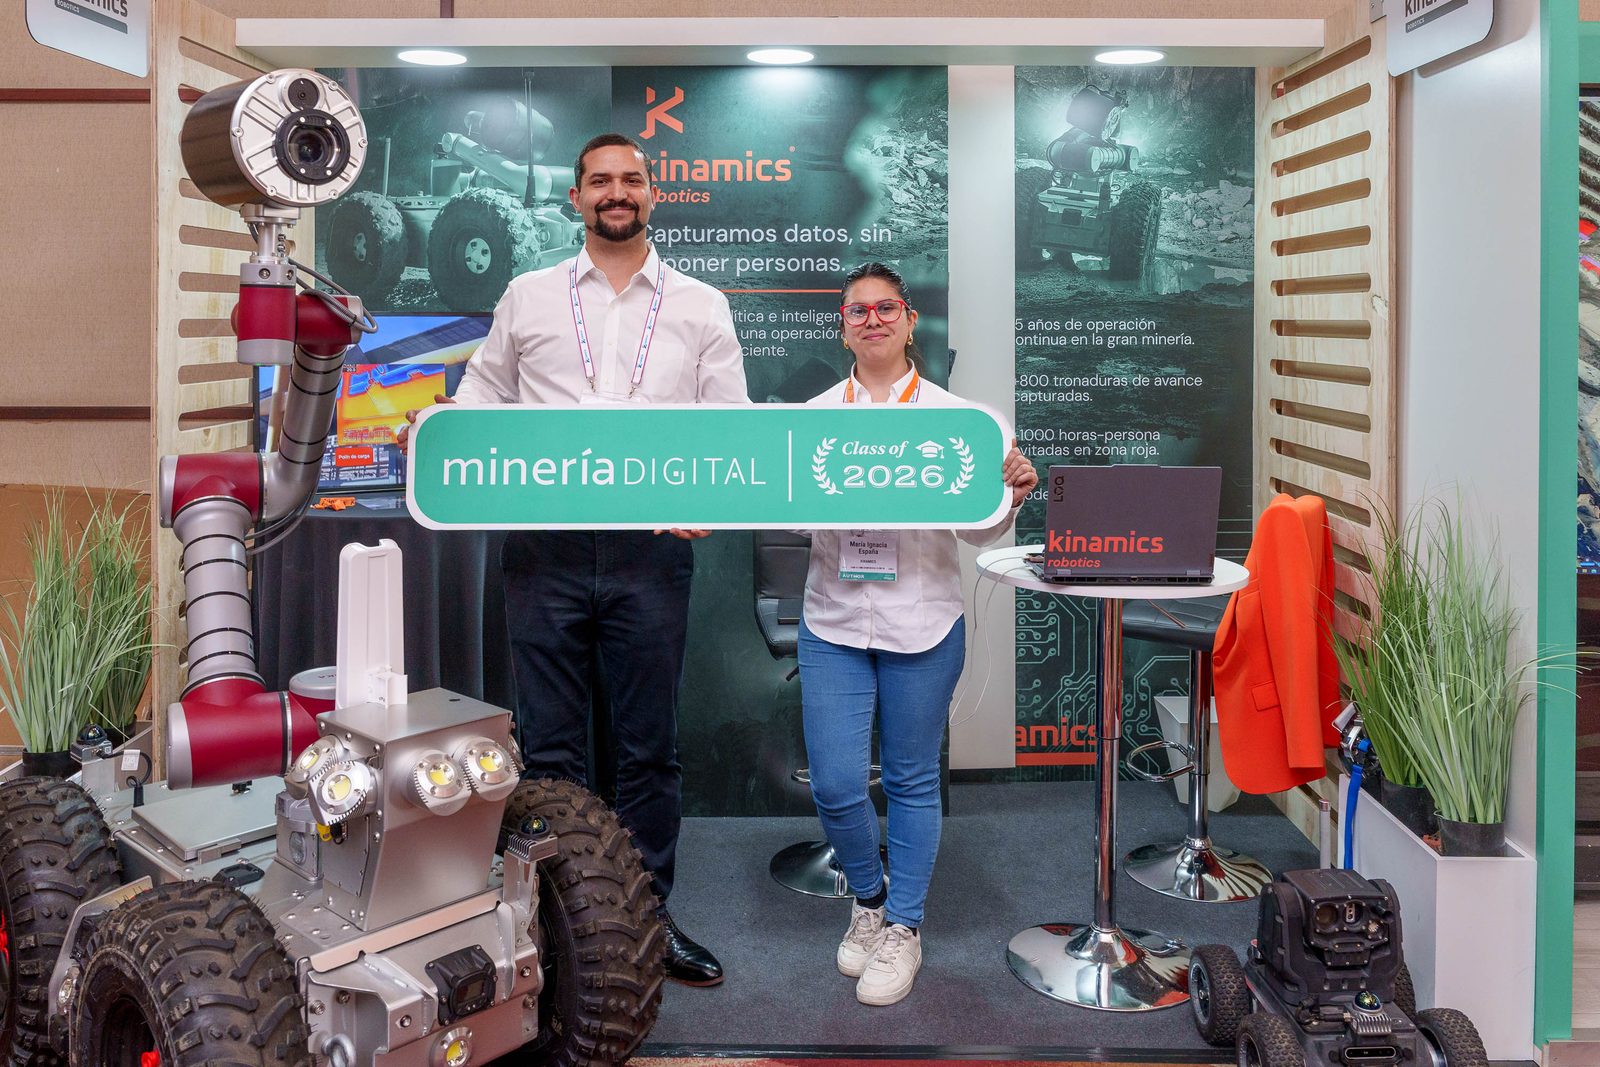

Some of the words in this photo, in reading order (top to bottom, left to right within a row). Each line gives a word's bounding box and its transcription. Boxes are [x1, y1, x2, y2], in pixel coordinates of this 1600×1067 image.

[656, 188, 711, 203] botics
[784, 223, 853, 245] datos,
[860, 223, 892, 242] sin
[663, 257, 729, 272] poner
[736, 257, 846, 276] personas.
[731, 310, 764, 322] lítica
[768, 312, 777, 322] e
[782, 310, 842, 326] inteligen
[1028, 318, 1060, 331] años
[1065, 318, 1082, 331] de
[1087, 318, 1156, 334] operación
[741, 330, 766, 339] una
[1015, 334, 1067, 346] ontinua
[1071, 336, 1088, 346] en
[1092, 334, 1104, 346] la
[1107, 336, 1138, 349] gran
[1142, 333, 1195, 346] minería.
[742, 344, 788, 357] ciente.
[1053, 374, 1128, 387] tronaduras
[1132, 374, 1150, 387] de
[1154, 377, 1203, 387] avance
[1059, 428, 1161, 445] horas-persona
[842, 440, 886, 456] Class
[888, 440, 909, 459] of
[1020, 444, 1071, 456] vitadas
[1074, 446, 1091, 456] en
[1095, 446, 1127, 456] zona
[1131, 444, 1160, 459] roja.
[443, 447, 615, 486] minería
[624, 457, 767, 486] DIGITAL
[843, 464, 945, 488] 2026
[1048, 529, 1164, 553] kinamics
[1047, 557, 1101, 568] robotics
[1015, 716, 1097, 746] amics
